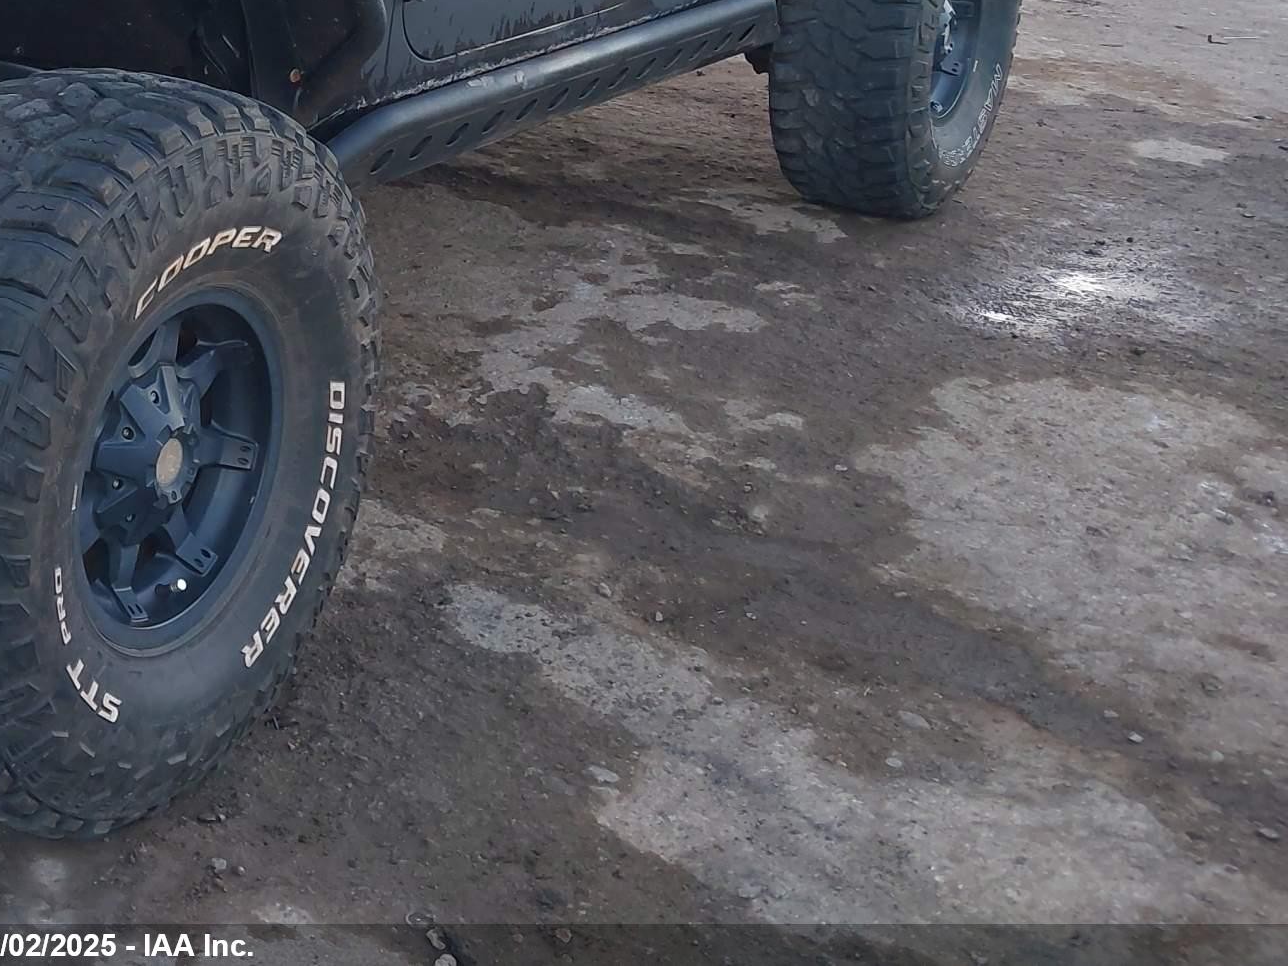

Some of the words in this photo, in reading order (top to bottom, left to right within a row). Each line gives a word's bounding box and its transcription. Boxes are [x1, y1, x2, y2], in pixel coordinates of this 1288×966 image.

[134, 225, 283, 321] COOPER
[240, 380, 346, 668] DISCOVERER
[54, 567, 72, 645] PRO
[66, 658, 122, 723] STT
